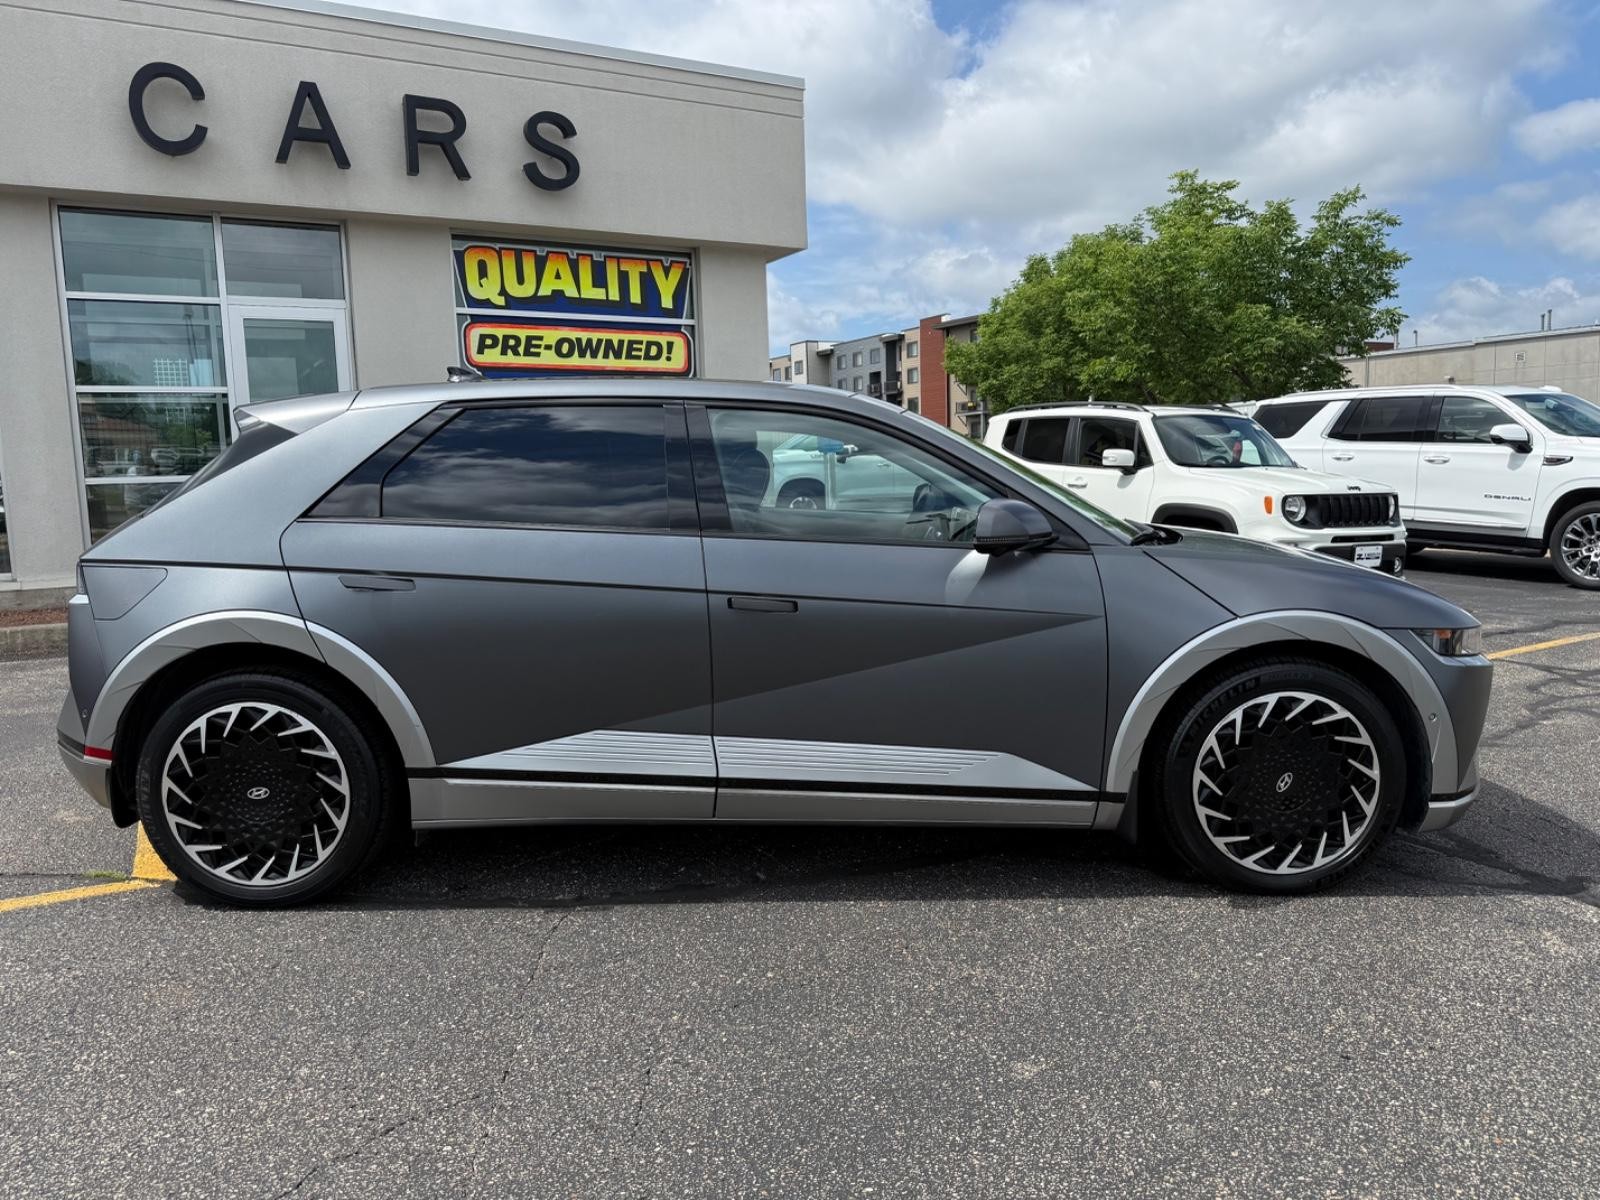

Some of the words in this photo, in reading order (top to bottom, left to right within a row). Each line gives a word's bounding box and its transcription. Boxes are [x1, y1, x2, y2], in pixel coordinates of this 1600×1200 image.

[129, 61, 580, 192] CARS
[464, 245, 686, 309] QUALITY
[476, 333, 675, 362] PRE-OWNED!
